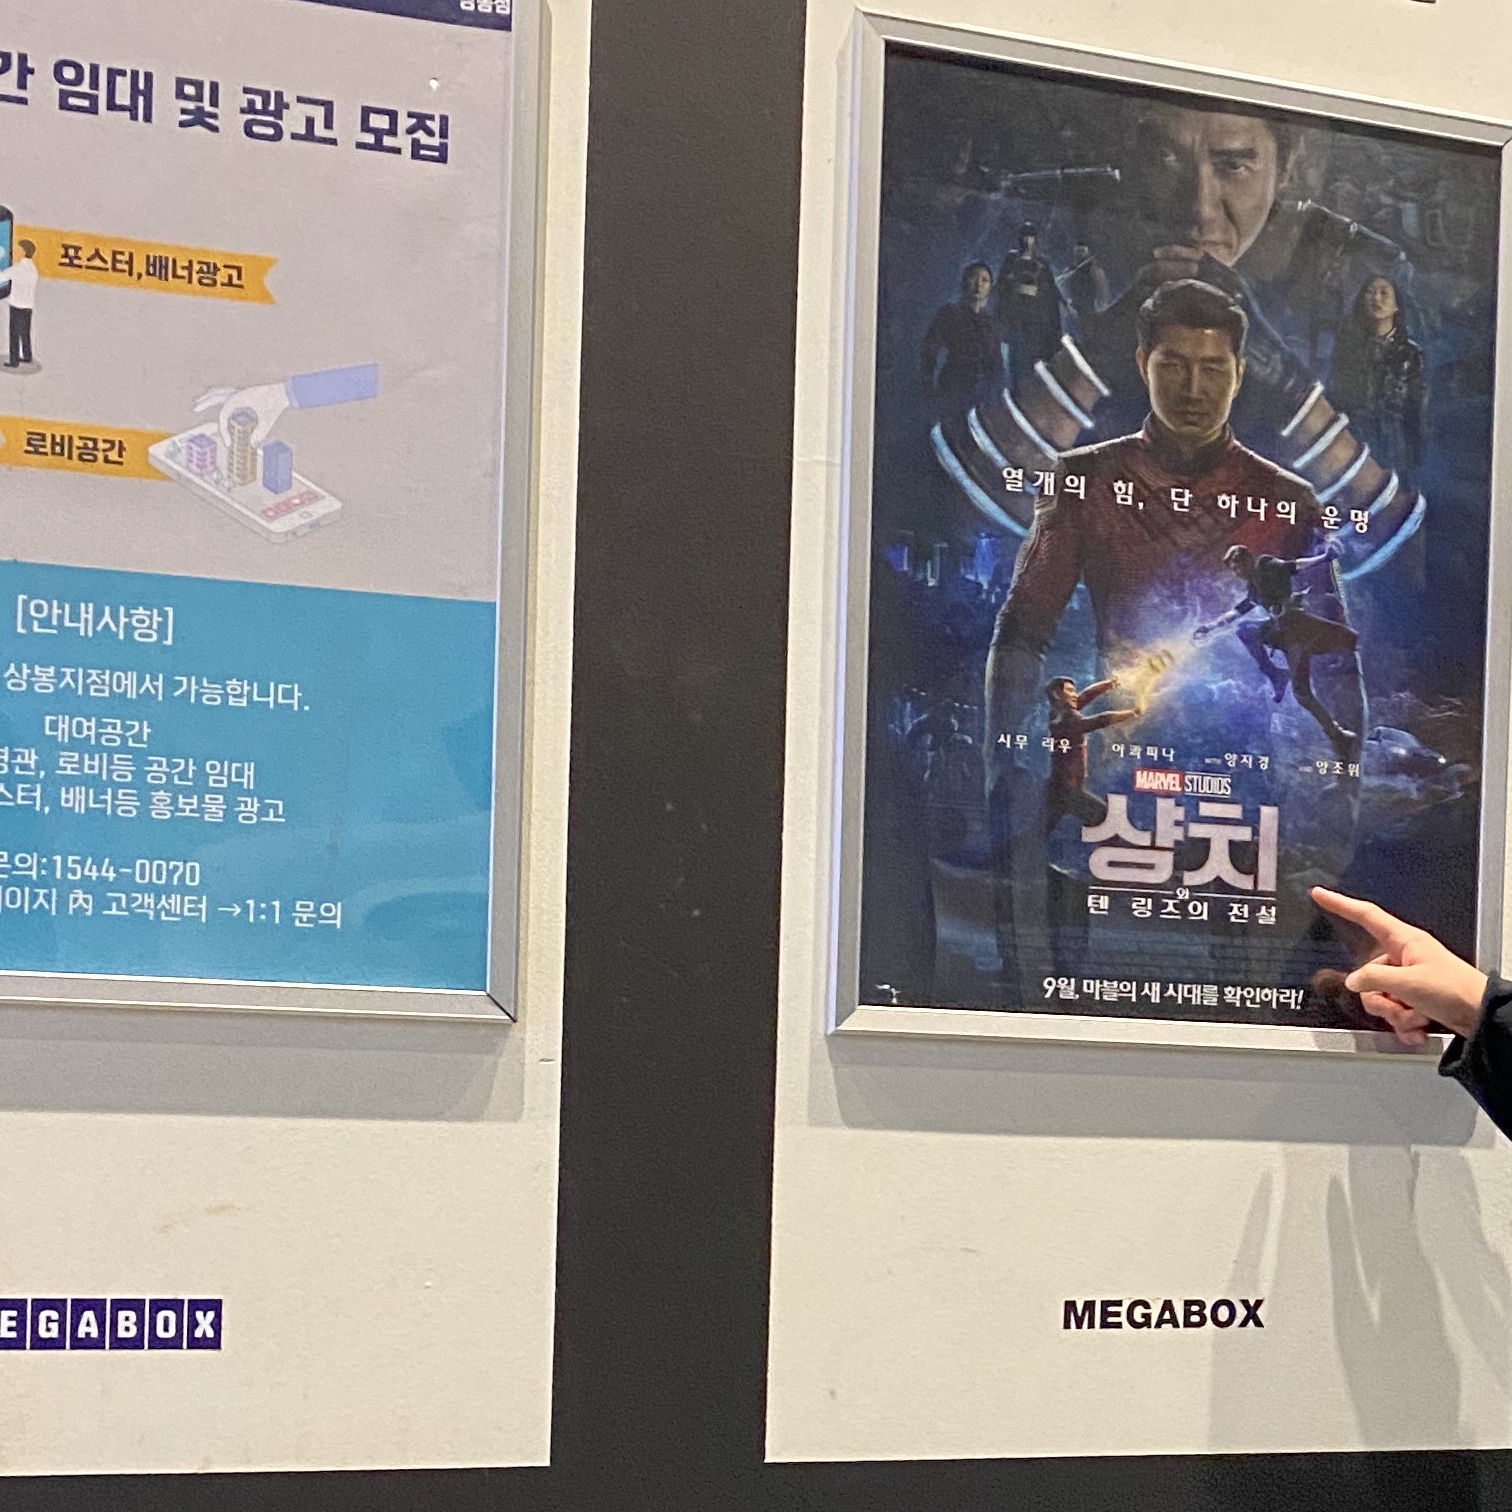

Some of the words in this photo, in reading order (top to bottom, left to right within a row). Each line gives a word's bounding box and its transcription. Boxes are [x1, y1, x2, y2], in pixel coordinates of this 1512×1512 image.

[53, 58, 154, 124] 임대
[174, 76, 220, 134] 및
[239, 84, 338, 147] 광고
[355, 104, 450, 164] 모집
[58, 243, 245, 289] 포스터,배너광고
[24, 432, 127, 466] 로비공간
[1002, 467, 1085, 499] 열개의
[1113, 479, 1145, 510] 힘,
[1171, 487, 1193, 512] 단
[1217, 493, 1296, 525] 하나의
[1321, 505, 1370, 534] 운명
[16, 594, 175, 645] [안내사항]
[3, 663, 164, 702] 상봉지점에서
[173, 675, 311, 711] 가능합니다.
[44, 715, 152, 748] 대여공간
[55, 751, 137, 783] 로비등
[144, 756, 197, 786] 공간
[205, 760, 256, 790] 임대
[1134, 770, 1183, 791] MARVEL
[1185, 774, 1232, 796] STUDIOS
[60, 785, 141, 818] 배너등
[149, 790, 228, 822] 홍보물
[234, 796, 286, 824] 광고
[1081, 793, 1279, 891] 샹치
[0, 885, 57, 916] 이지
[102, 891, 207, 923] 고객센터
[246, 899, 281, 924] 1:1
[291, 899, 342, 929] 문의
[1087, 893, 1109, 915] 텐
[1131, 896, 1209, 920] 링즈의
[1228, 900, 1277, 925] 전설
[1083, 979, 1137, 1002] 마블의
[1141, 982, 1161, 1003] 새
[1164, 984, 1219, 1006] 시대를
[1224, 985, 1304, 1009] 확인하라!
[1063, 1298, 1264, 1329] MEGABOX
